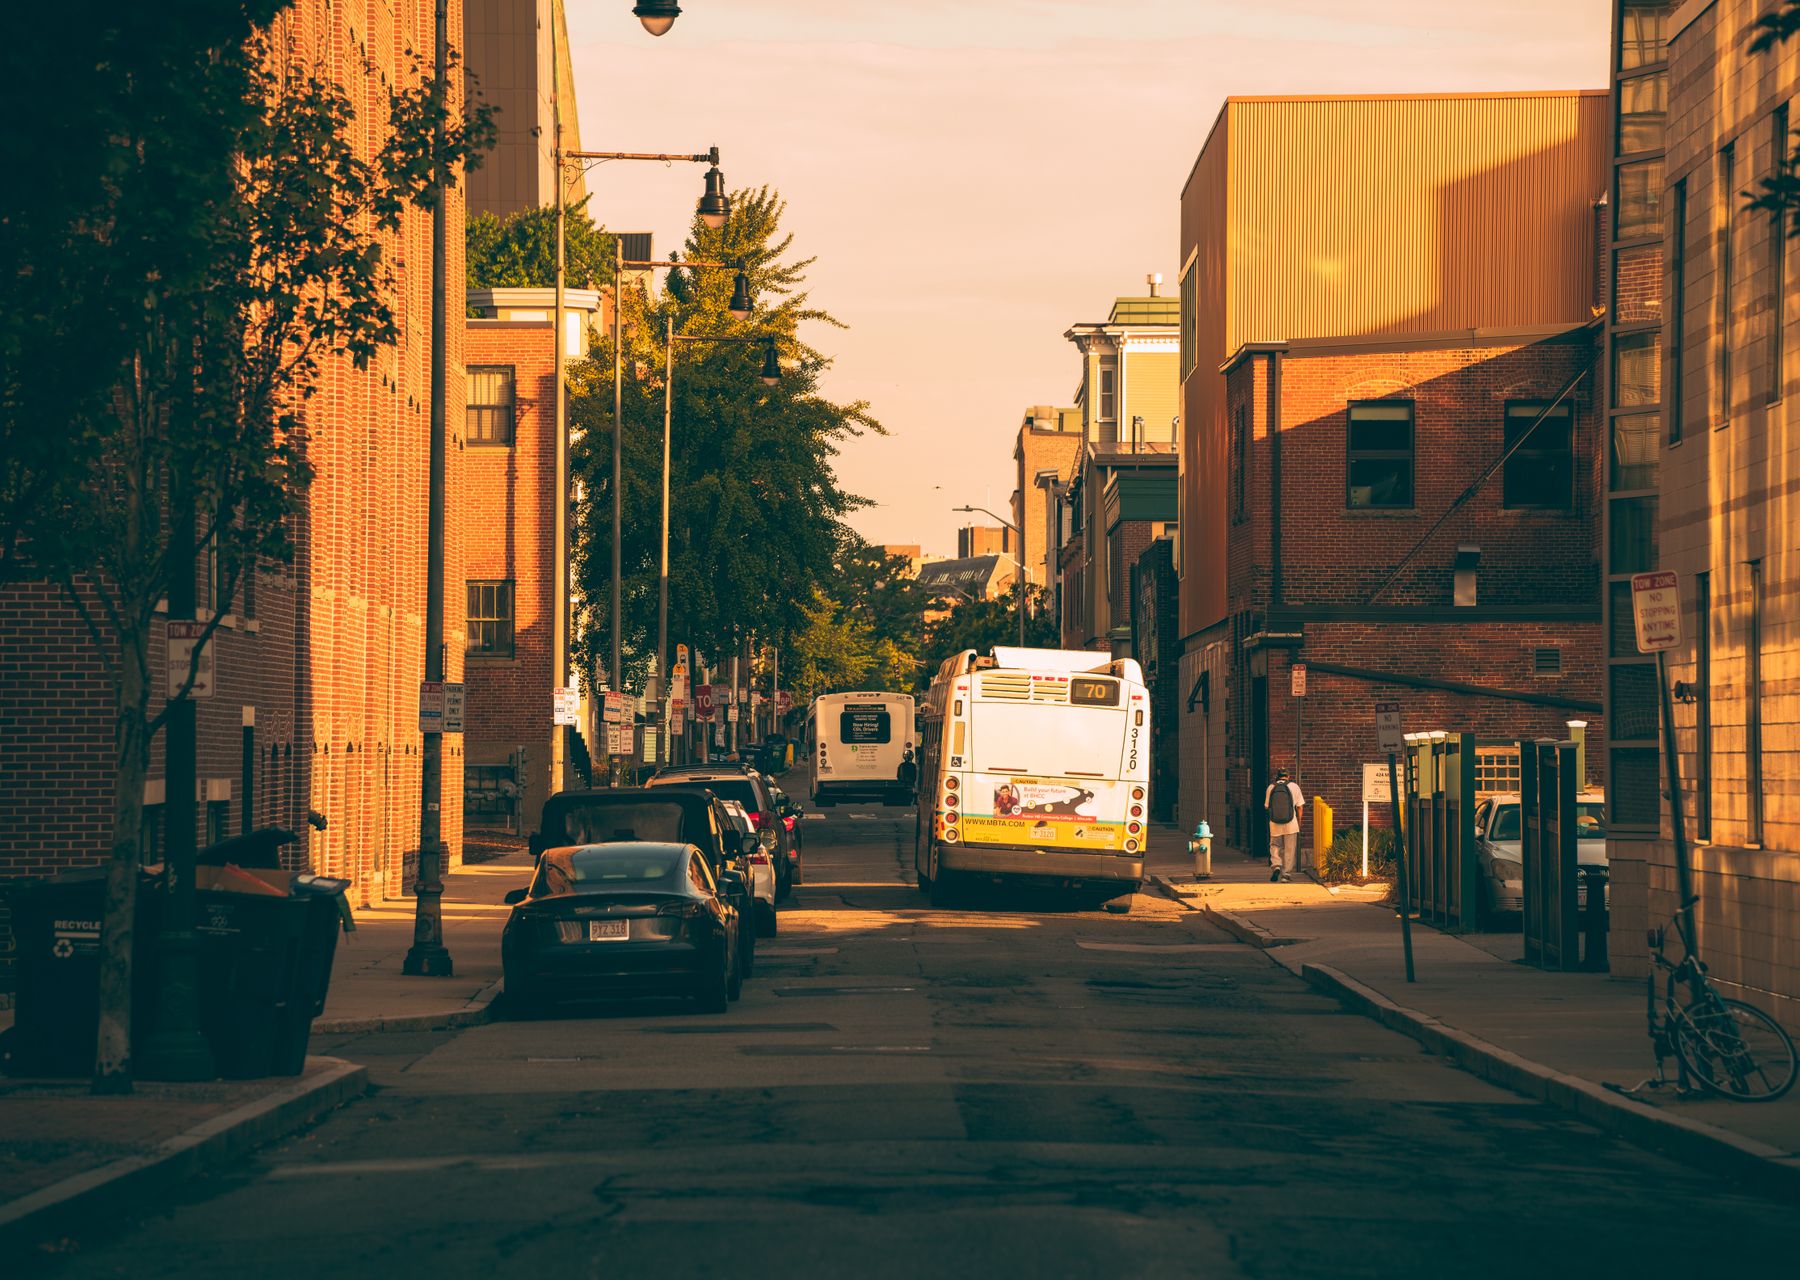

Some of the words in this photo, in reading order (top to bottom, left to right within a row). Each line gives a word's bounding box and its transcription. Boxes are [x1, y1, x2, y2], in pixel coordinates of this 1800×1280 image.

[1634, 578, 1651, 590] TOW
[1654, 575, 1676, 588] ZONE
[1649, 592, 1663, 602] NO
[1640, 605, 1676, 618] STOPPING
[170, 624, 187, 637] TOW
[1643, 620, 1676, 632] ANYTIME
[1083, 683, 1106, 699] 70
[1384, 713, 1392, 721] NO
[1129, 727, 1139, 770] 3120
[965, 817, 1026, 828] WWW.MBTA.COM
[54, 920, 102, 930] RECYCLE
